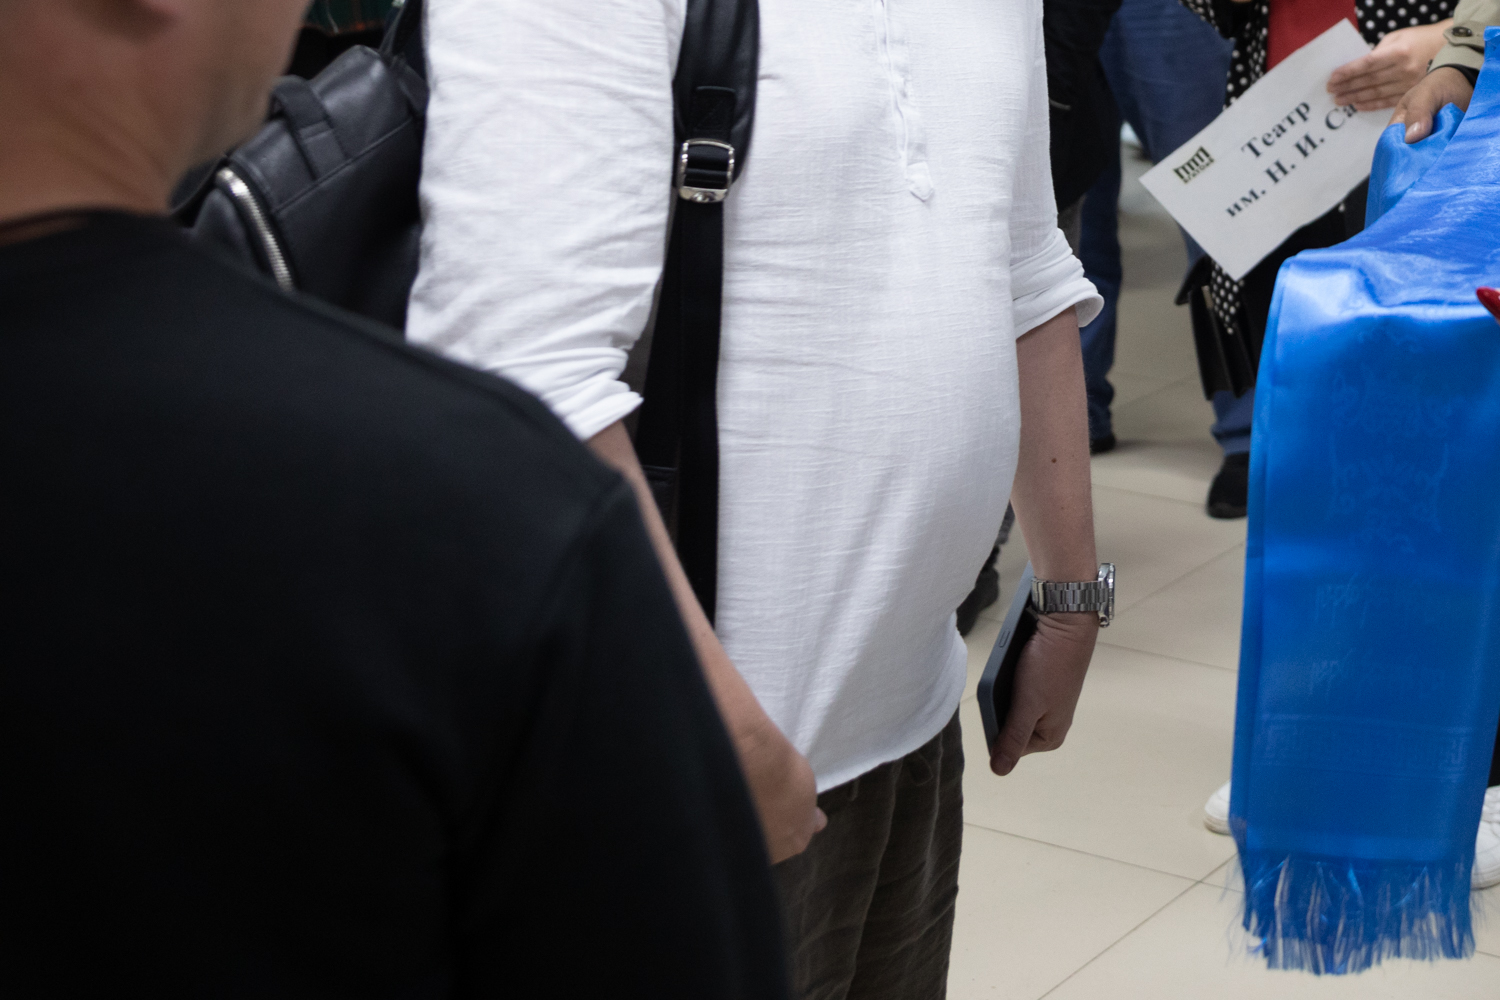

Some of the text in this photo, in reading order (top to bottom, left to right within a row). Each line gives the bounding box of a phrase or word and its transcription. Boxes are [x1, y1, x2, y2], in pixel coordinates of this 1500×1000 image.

[1241, 101, 1312, 160] Театр
[1225, 187, 1267, 218] им.
[1263, 157, 1297, 185] Н.
[1295, 131, 1326, 160] И.
